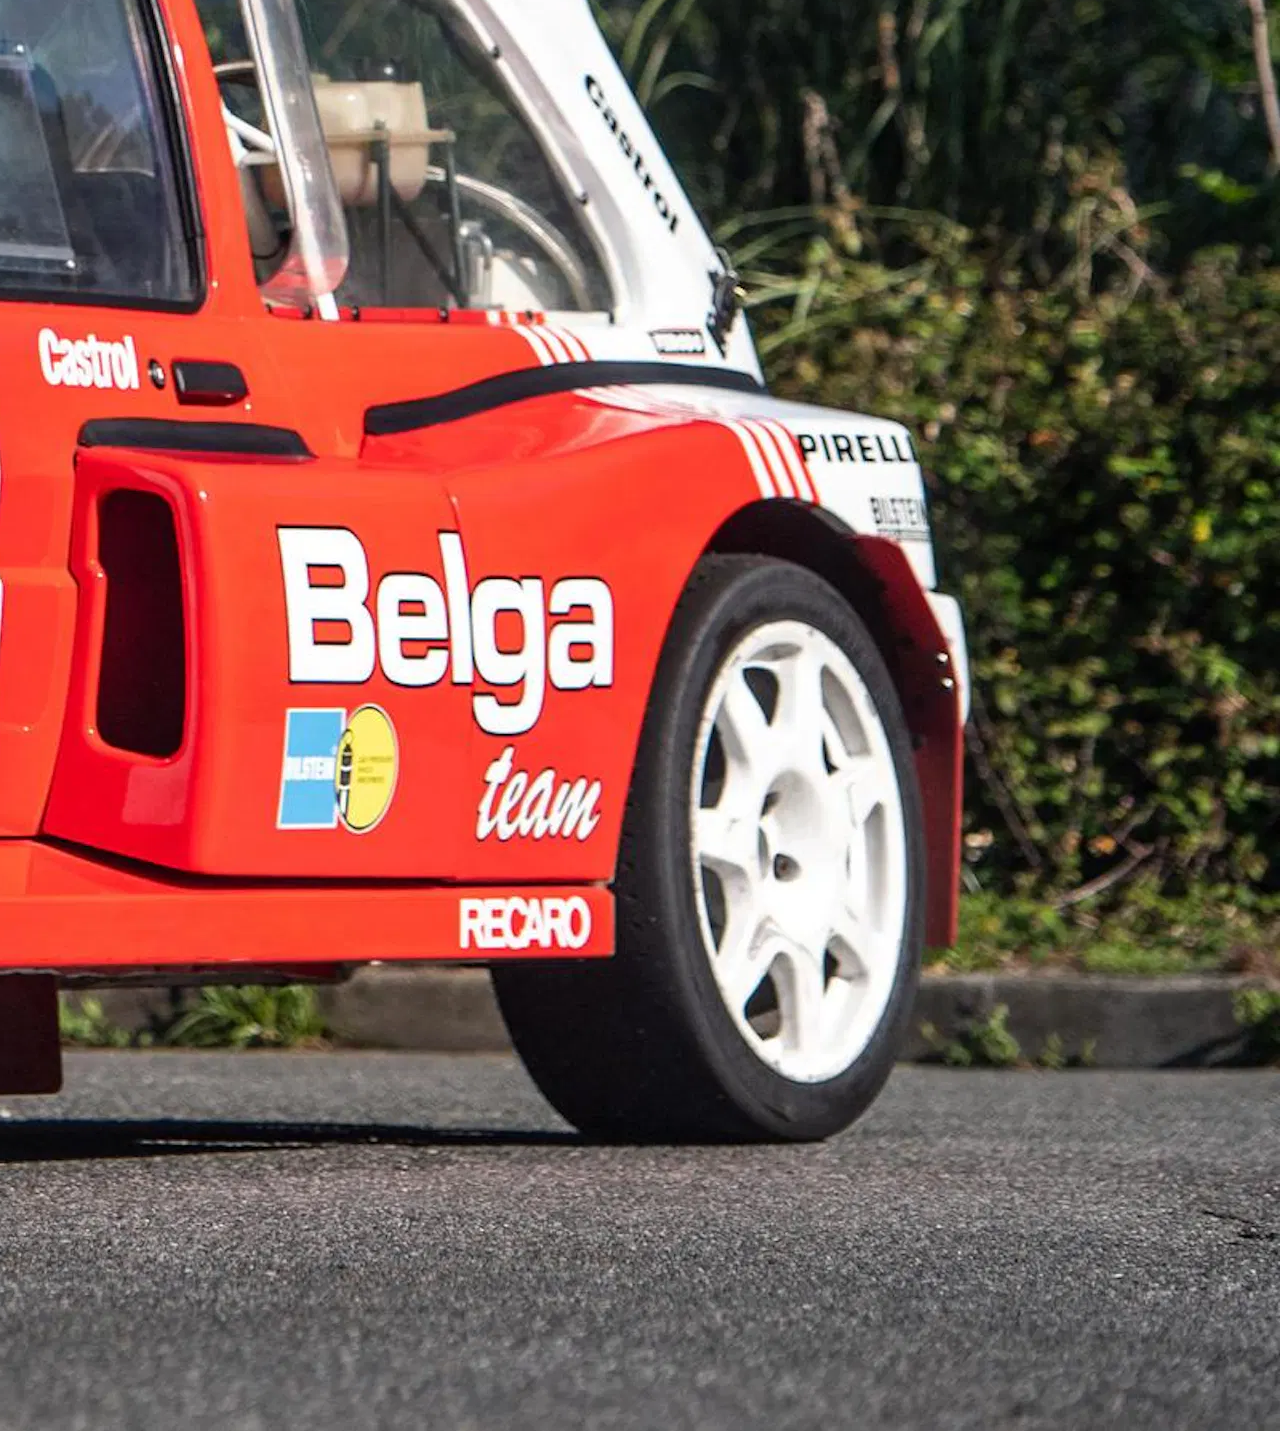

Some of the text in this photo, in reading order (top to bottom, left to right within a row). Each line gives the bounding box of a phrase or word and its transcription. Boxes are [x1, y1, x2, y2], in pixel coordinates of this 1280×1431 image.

[585, 74, 678, 233] Castrol
[38, 327, 139, 390] Castrol
[276, 525, 614, 736] Belga
[476, 745, 602, 842] team
[459, 896, 591, 950] RECARO
